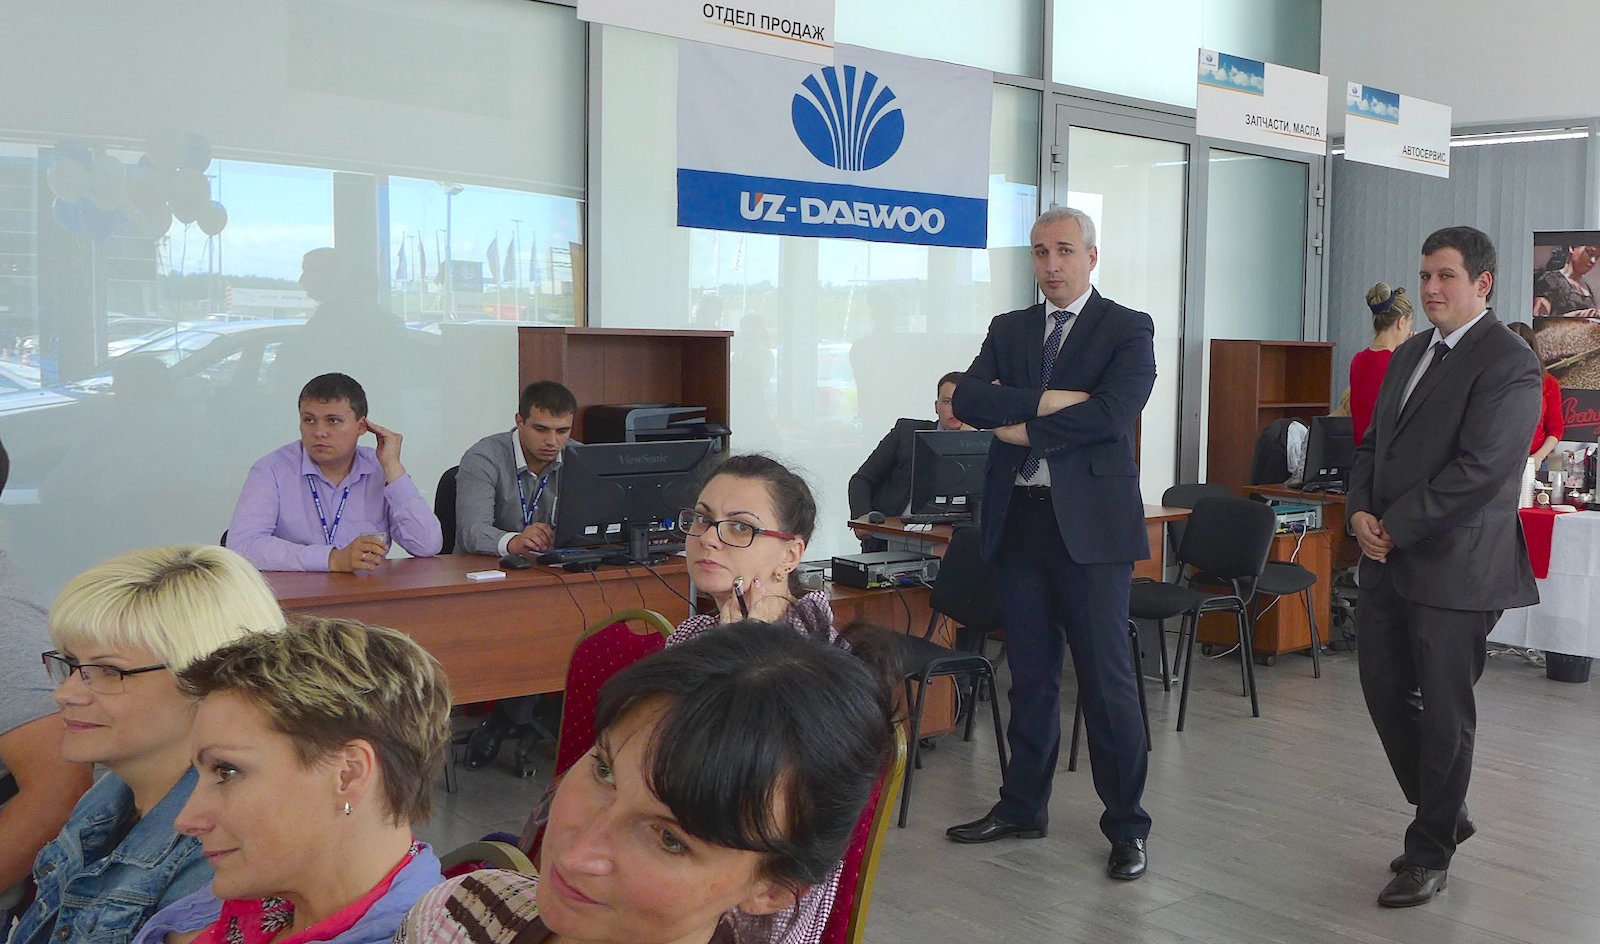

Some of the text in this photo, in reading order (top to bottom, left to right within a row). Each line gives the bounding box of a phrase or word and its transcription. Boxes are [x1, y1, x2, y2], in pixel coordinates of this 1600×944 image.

[703, 3, 824, 41] ОТДЕЛ ПРОДАЖ
[1245, 114, 1320, 137] ЗАПЧАСТИ, МАСЛА
[1402, 145, 1446, 162] АВТОСЕРВИС
[740, 191, 945, 234] UZ-DAEWOO
[1561, 397, 1600, 424] Bar
[619, 453, 669, 465] ViewSonic
